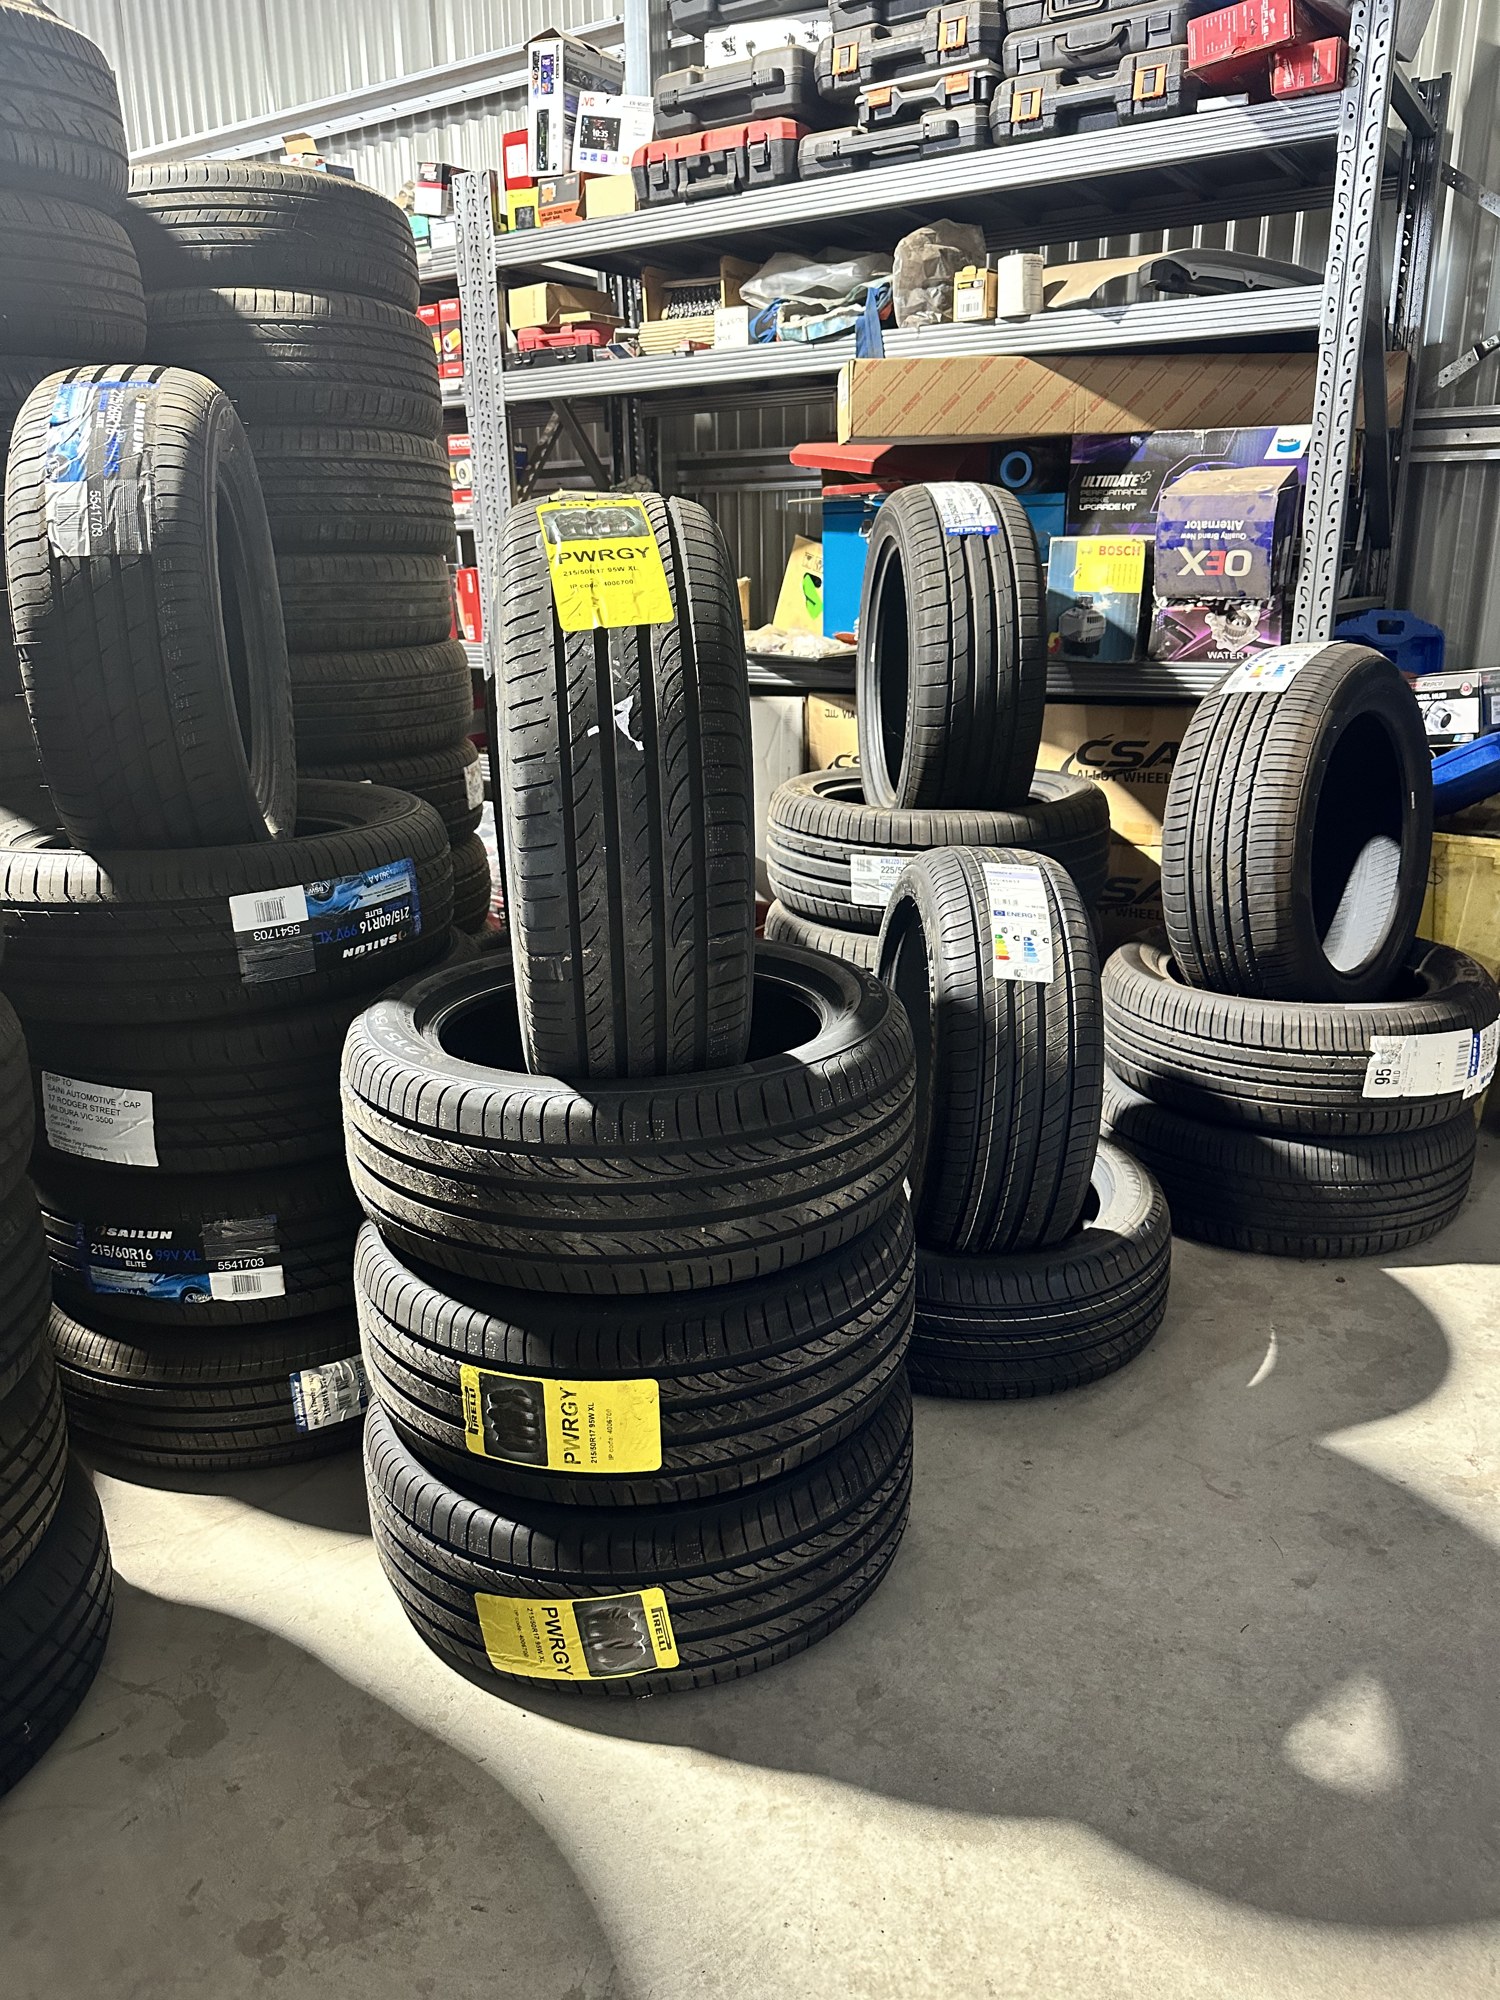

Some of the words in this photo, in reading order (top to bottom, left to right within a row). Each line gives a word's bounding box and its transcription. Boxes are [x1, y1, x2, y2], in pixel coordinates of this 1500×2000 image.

[592, 129, 609, 138] 10:35
[133, 401, 146, 453] SAILUN
[89, 489, 103, 537] 5541703
[1079, 503, 1121, 511] UPGRADE
[1122, 503, 1137, 511] KIT
[1184, 519, 1244, 530] Alternator
[1180, 532, 1196, 540] New
[1198, 532, 1220, 541] Brand
[1220, 532, 1246, 541] Quality
[558, 546, 650, 565] PWRGY
[1098, 545, 1141, 556] BOSCH
[1177, 547, 1253, 578] OEX
[1207, 651, 1245, 660] WATER
[1077, 769, 1118, 782] ALLOY
[359, 906, 410, 934] 215/60R16
[365, 907, 383, 918] ELITE
[253, 924, 301, 941] 5541703
[343, 933, 398, 958] SAILUN
[45, 1073, 60, 1083] SHIP
[1374, 1068, 1392, 1086] 95
[47, 1084, 65, 1095] SAINI
[66, 1089, 116, 1106] AUTOMOTIVE
[123, 1100, 142, 1109] CAP
[48, 1103, 79, 1117] MILDURA
[80, 1112, 94, 1121] VIC
[95, 1115, 114, 1125] 3500
[56, 1096, 88, 1109] RODGER
[89, 1104, 121, 1116] STREET
[106, 1227, 173, 1240] SAILUN
[90, 1243, 153, 1261] 215/60R16
[155, 1249, 179, 1261] 99V
[183, 1249, 201, 1260] XL
[125, 1259, 147, 1268] ELITE
[217, 1257, 265, 1271] 5541703
[465, 1386, 478, 1435] PIRELLI
[588, 1402, 595, 1411] XL
[560, 1386, 582, 1465] PWRGY
[588, 1411, 597, 1428] 95W
[589, 1430, 598, 1464] 215/50R17
[651, 1606, 671, 1651] PIRELLI
[541, 1606, 574, 1676] PWRGY
